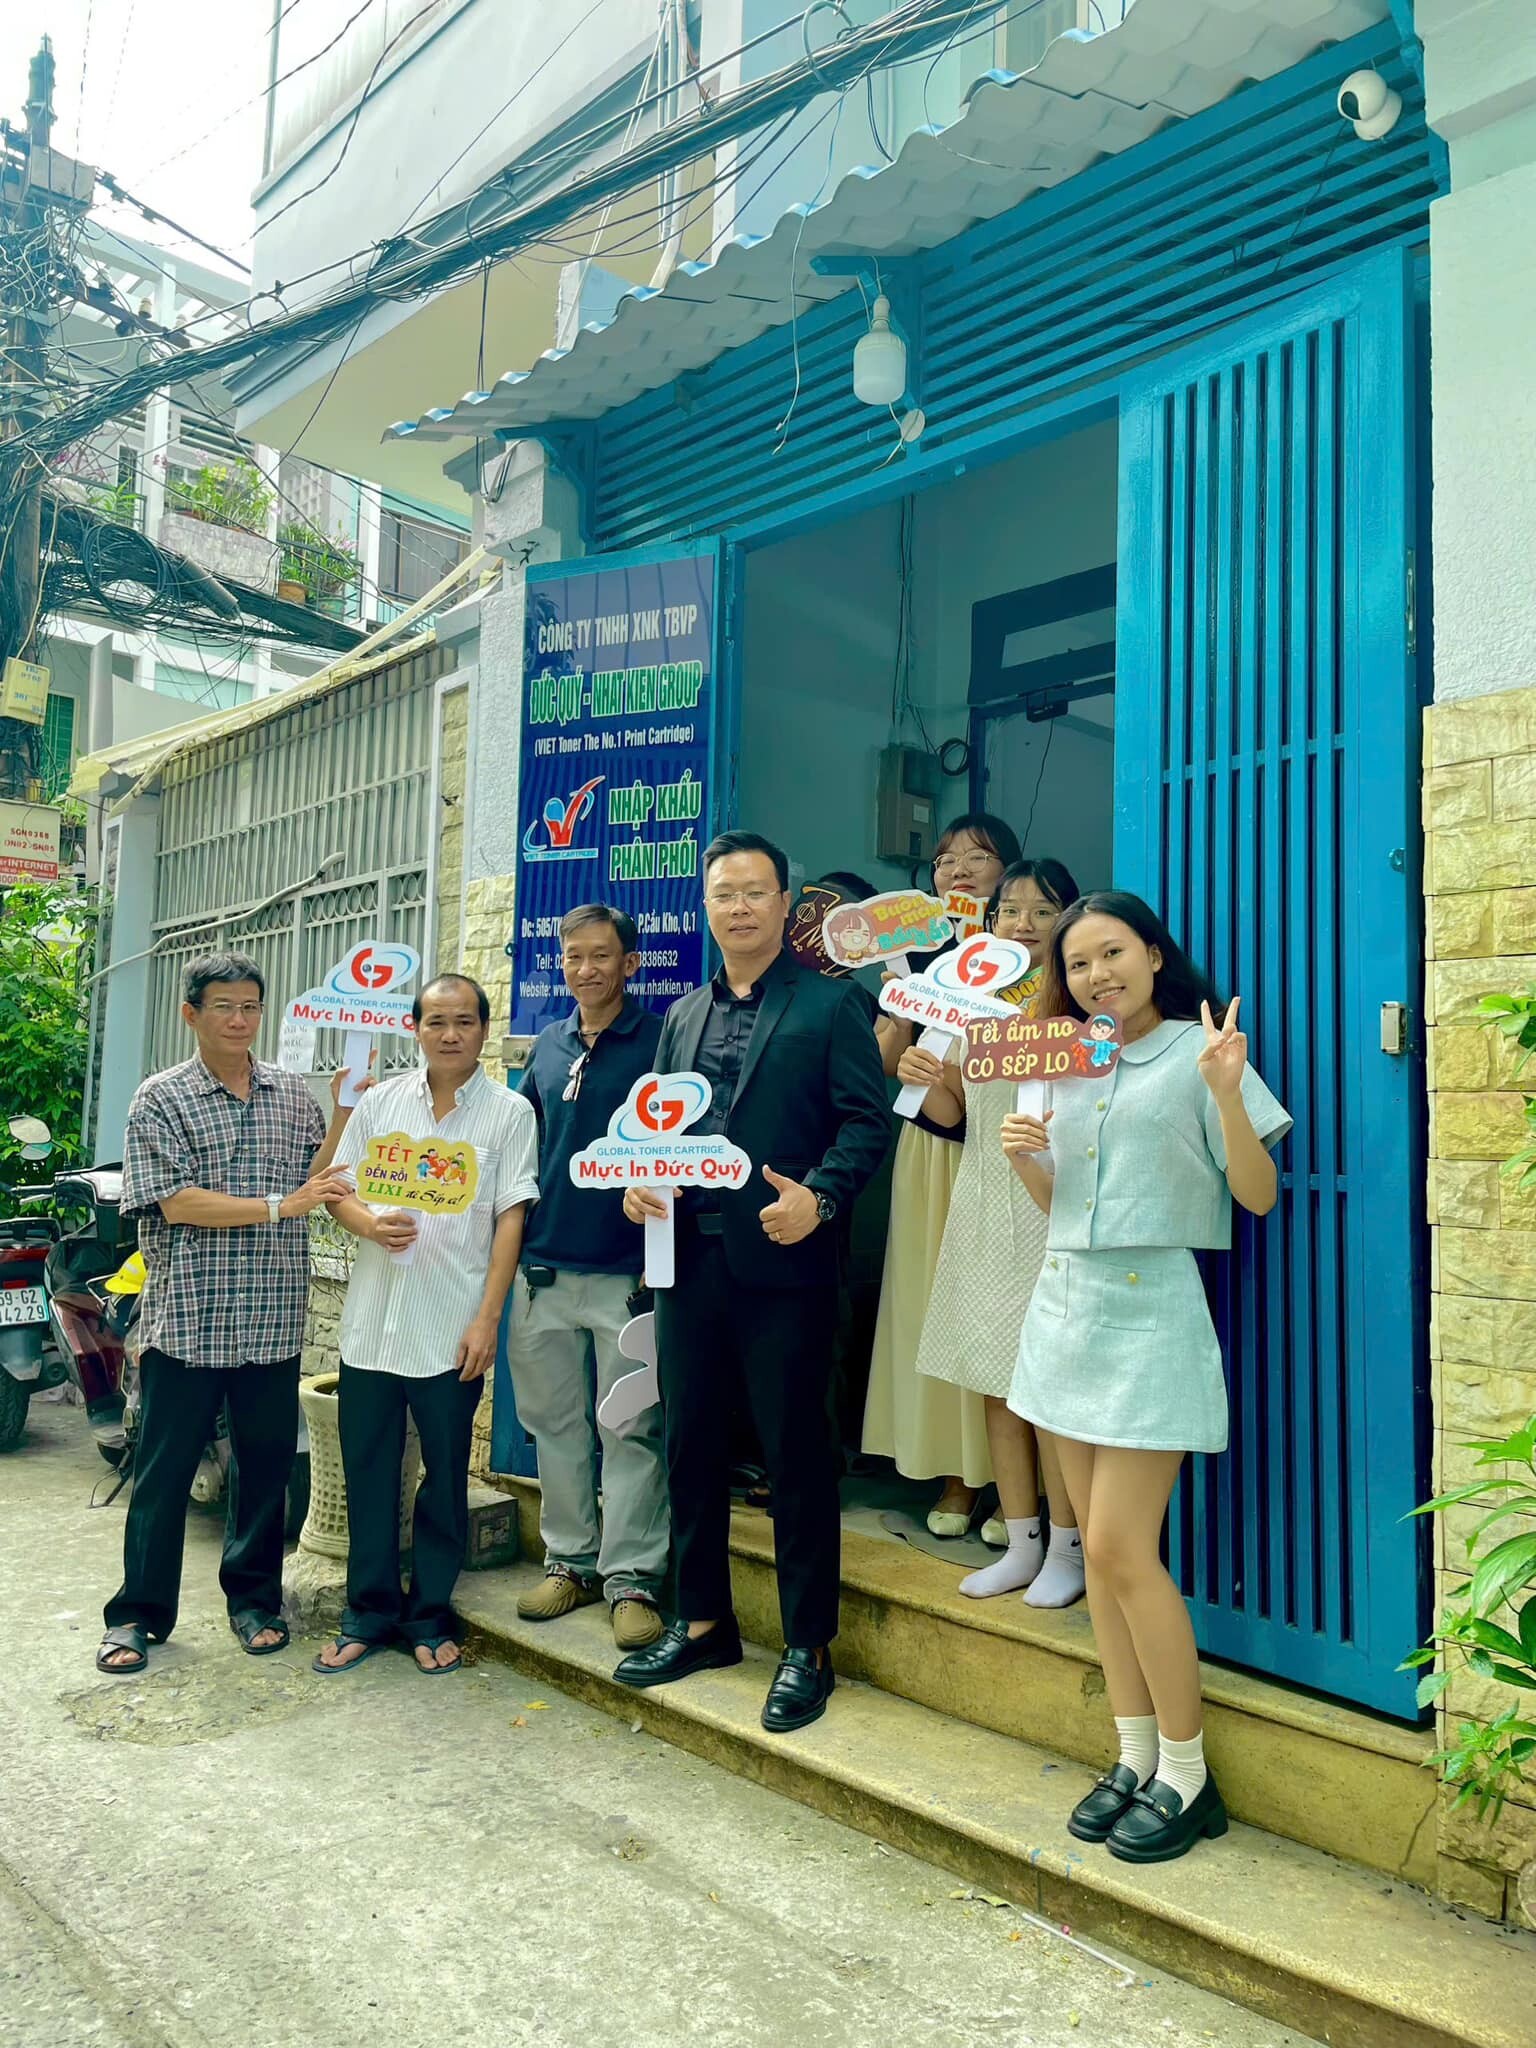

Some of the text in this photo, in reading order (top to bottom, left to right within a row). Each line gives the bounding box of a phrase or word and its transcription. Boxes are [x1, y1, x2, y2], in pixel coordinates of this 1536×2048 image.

[538, 604, 698, 655] CÔNG TY TNHH XNK TBVP
[529, 669, 557, 724] ĐỨC
[557, 664, 584, 726] QUÝ
[591, 669, 626, 718] NHAT
[625, 665, 658, 714] KIEN
[658, 659, 703, 711] GROUP
[534, 723, 695, 758] (VIET Toner The No.1 Print Cartridge)
[608, 768, 702, 831] NHẬP KHẨU
[608, 828, 698, 881] PHÂN PHỐI
[946, 895, 978, 916] Xin
[662, 911, 681, 935] Kho,
[683, 911, 697, 935] Q.1
[536, 953, 553, 970] Tell:
[519, 981, 551, 997] Website:
[909, 981, 941, 998] GLOBAL
[943, 992, 970, 1009] TONER
[970, 1002, 1008, 1019] CARTRIG
[293, 1003, 333, 1023] Mực
[339, 1008, 355, 1023] In
[361, 1010, 396, 1027] Đức
[311, 995, 413, 1012] GLOBAL TONER CARTRI
[886, 988, 970, 1029] Mực In Đứ
[968, 1015, 1077, 1045] Tết ấm no
[967, 1043, 1070, 1079] CÓ SẾP LO
[376, 1138, 414, 1163] TẾT
[596, 1145, 724, 1157] GLOBAL TONER CARTRIGE
[365, 1163, 388, 1180] ĐẾN
[579, 1158, 743, 1182] Mực In Đức Quý
[366, 1181, 404, 1197] LIXI
[0, 1305, 45, 1324] 42.29
